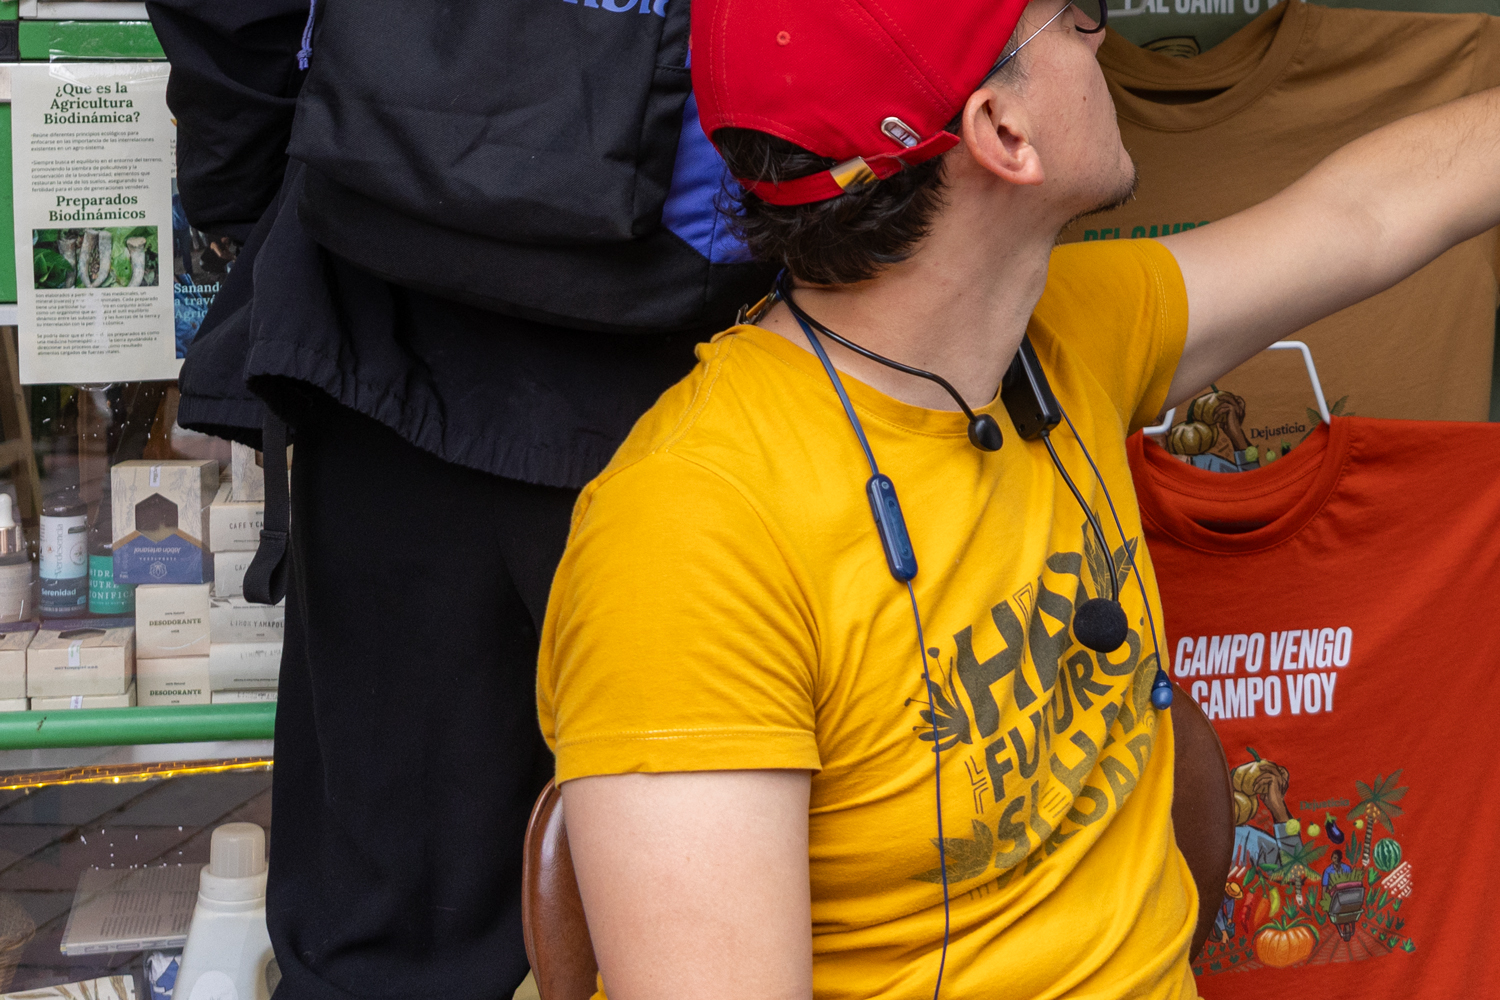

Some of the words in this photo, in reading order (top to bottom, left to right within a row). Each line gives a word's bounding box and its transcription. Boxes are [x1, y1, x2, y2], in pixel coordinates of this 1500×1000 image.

[97, 85, 112, 94] es
[115, 82, 128, 94] la
[50, 97, 134, 112] Agricultura
[44, 111, 140, 125] Biodinámica?
[56, 194, 138, 210] Preparados
[48, 208, 146, 222] Biodinámicos
[174, 281, 222, 293] Sanand
[1250, 422, 1305, 440] Dejusticia
[41, 588, 76, 596] Serenidad
[149, 618, 201, 626] DESODORANTE
[1174, 632, 1264, 678] CAMPO
[1270, 626, 1353, 672] VENGO
[1191, 674, 1282, 720] CAMPO
[1287, 672, 1337, 715] VOY
[985, 628, 1141, 803] FUURO
